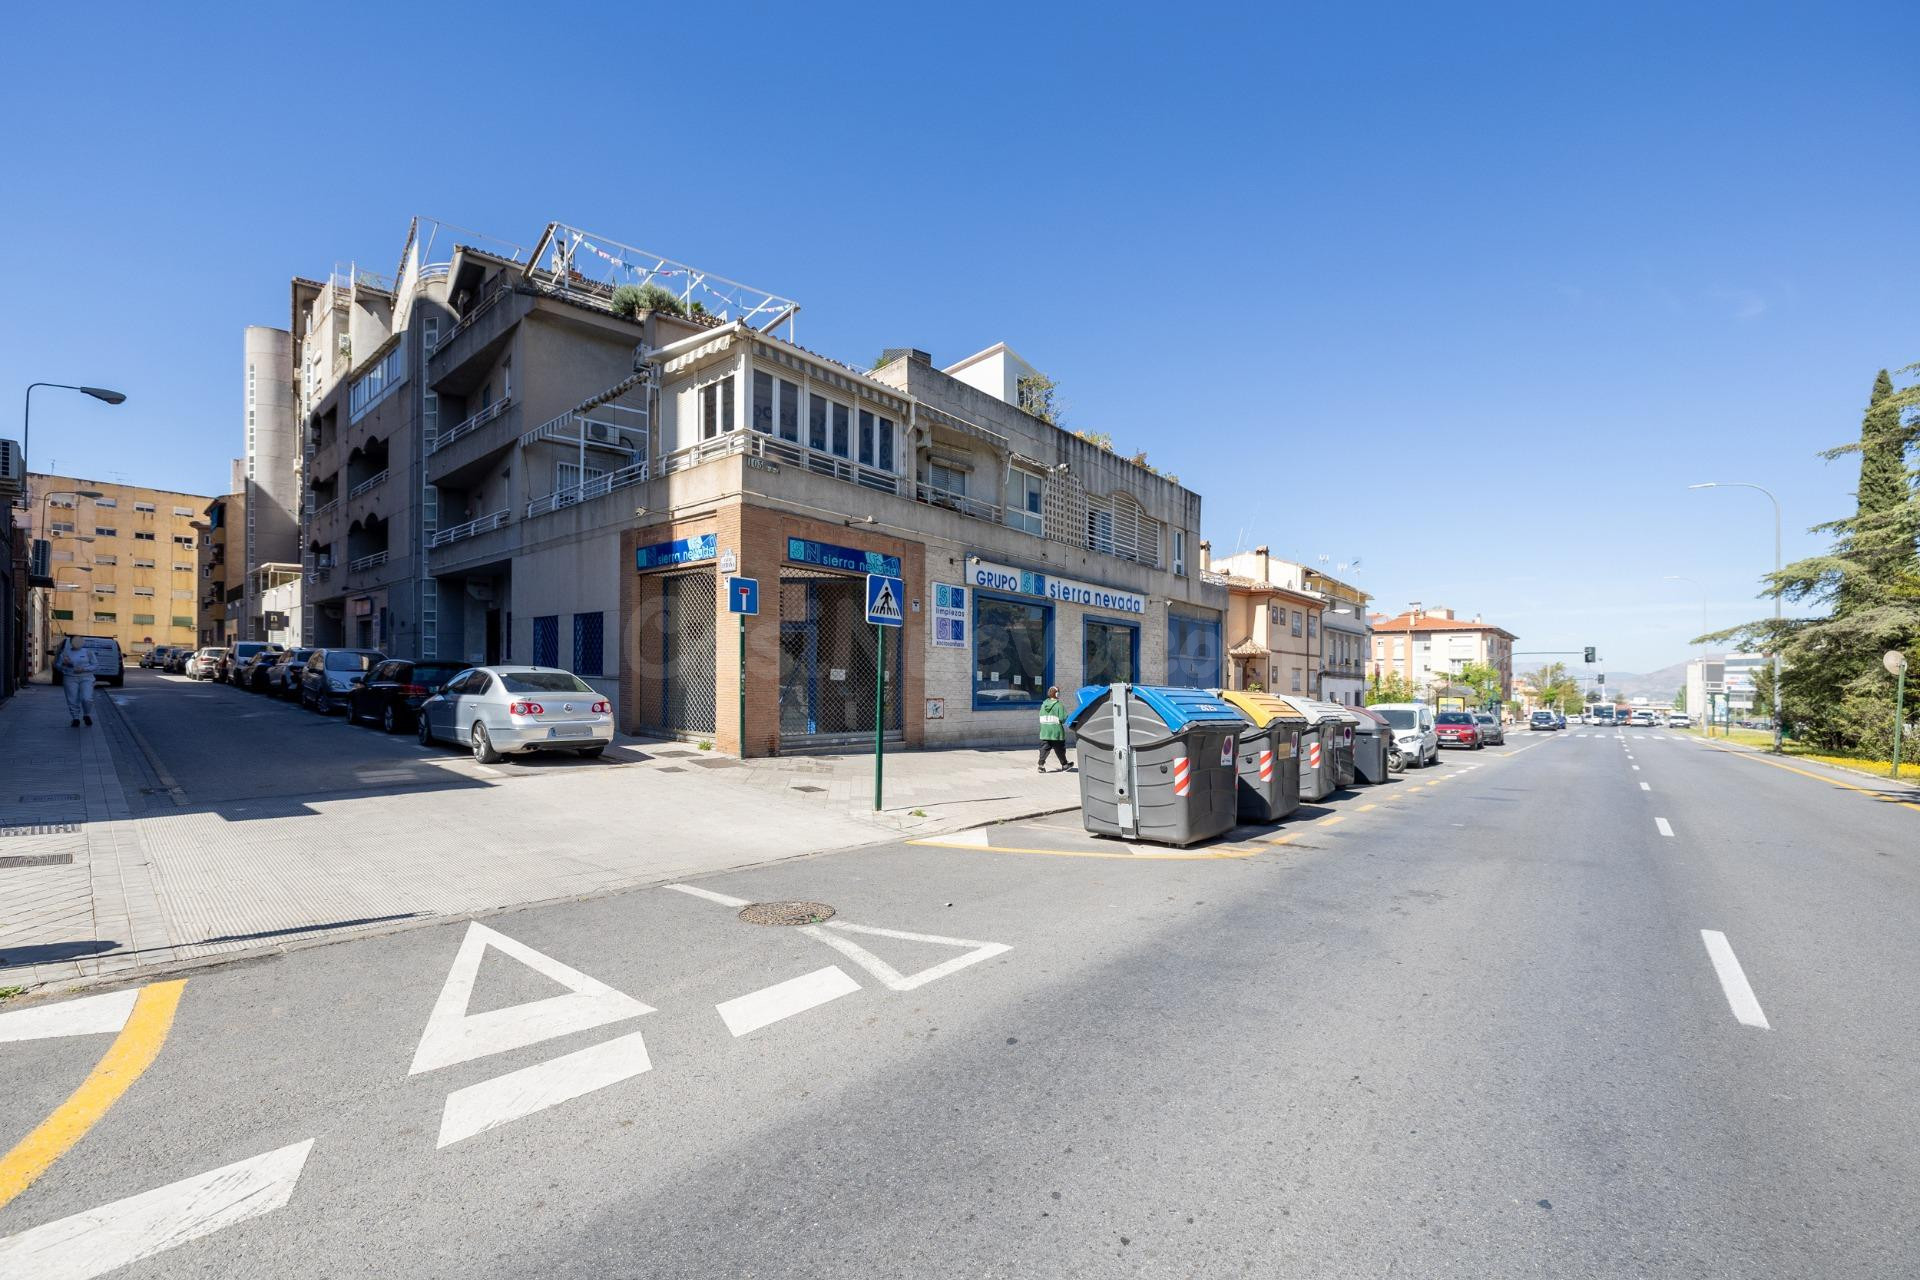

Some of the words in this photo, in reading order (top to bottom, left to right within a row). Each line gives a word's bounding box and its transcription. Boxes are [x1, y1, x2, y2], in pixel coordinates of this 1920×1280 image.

[658, 552, 680, 565] sierra
[823, 554, 855, 570] sierra
[976, 570, 1018, 591] GRUPO
[1050, 580, 1091, 605] sierra
[1095, 592, 1140, 613] nevada
[936, 607, 965, 618] limpiezas
